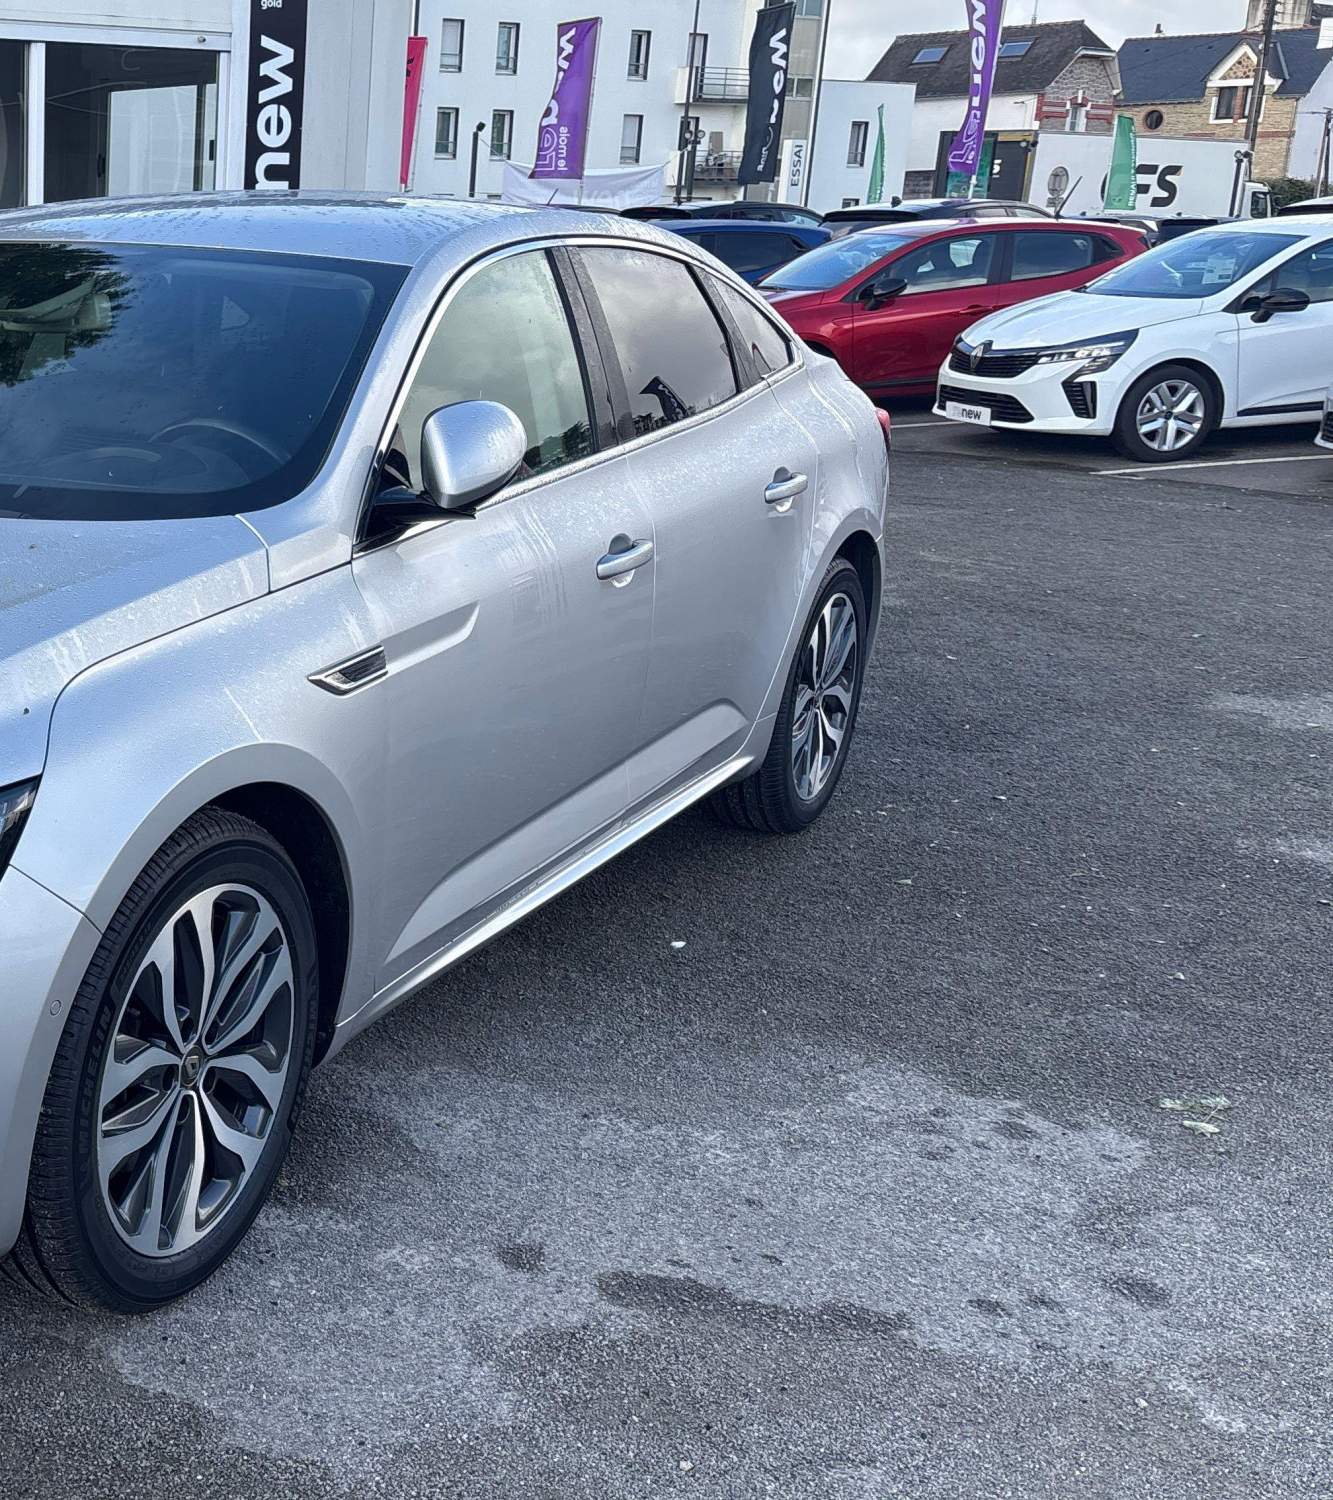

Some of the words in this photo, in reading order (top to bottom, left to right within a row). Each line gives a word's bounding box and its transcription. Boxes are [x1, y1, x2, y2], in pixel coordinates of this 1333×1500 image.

[261, 0, 283, 10] gold
[791, 145, 803, 187] ESSAI
[1101, 164, 1183, 207] FS
